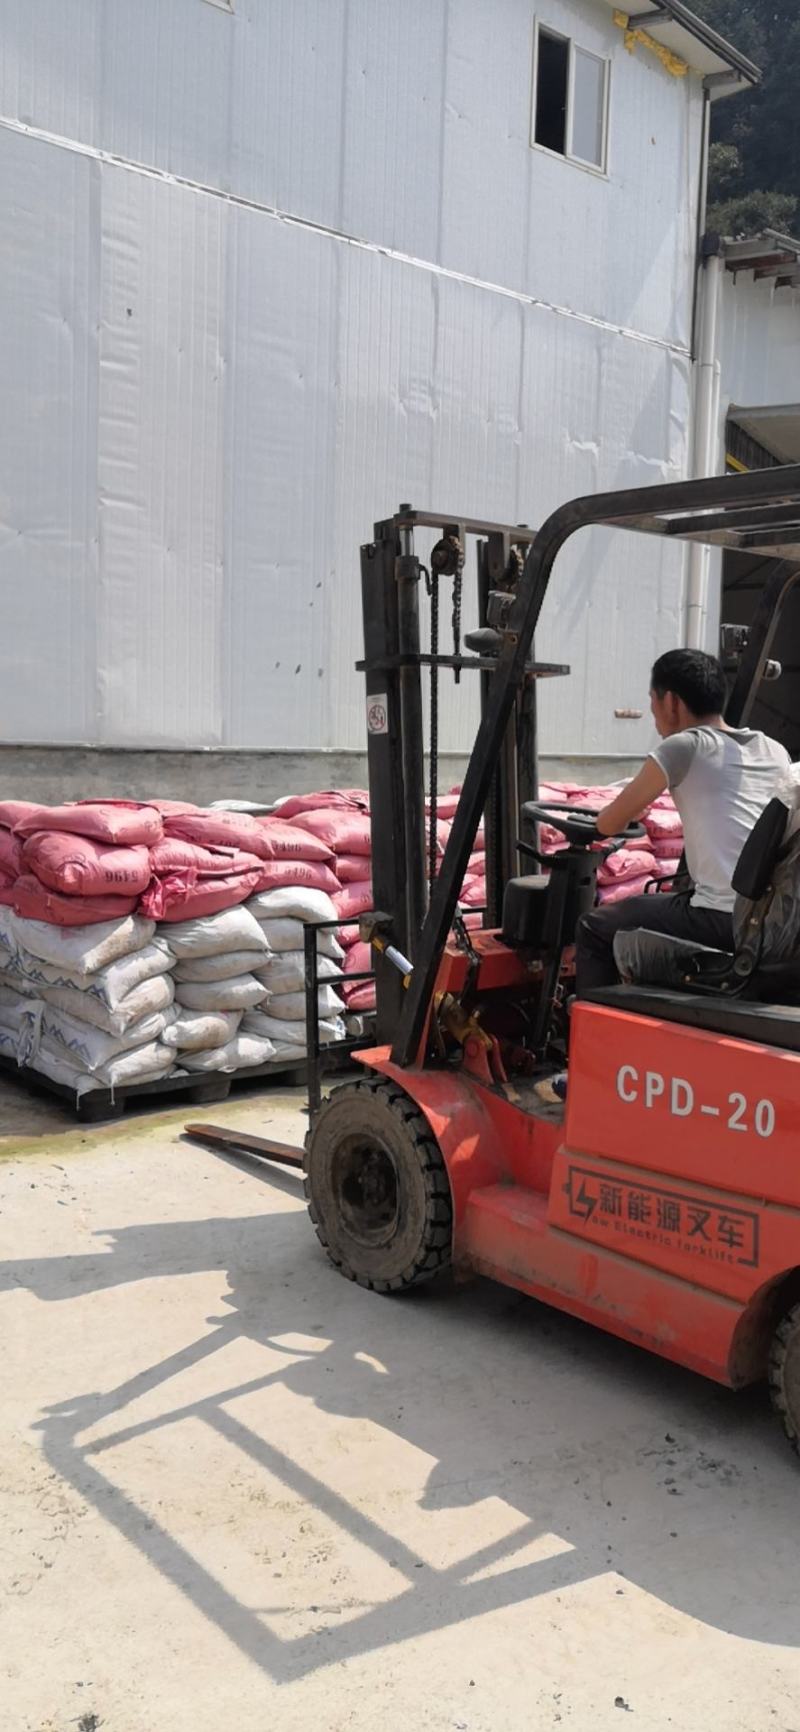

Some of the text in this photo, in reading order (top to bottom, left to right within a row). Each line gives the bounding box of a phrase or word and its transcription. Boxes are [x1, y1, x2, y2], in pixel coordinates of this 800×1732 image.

[616, 1064, 776, 1138] CPD-20
[599, 1183, 745, 1249] 新能源叉车
